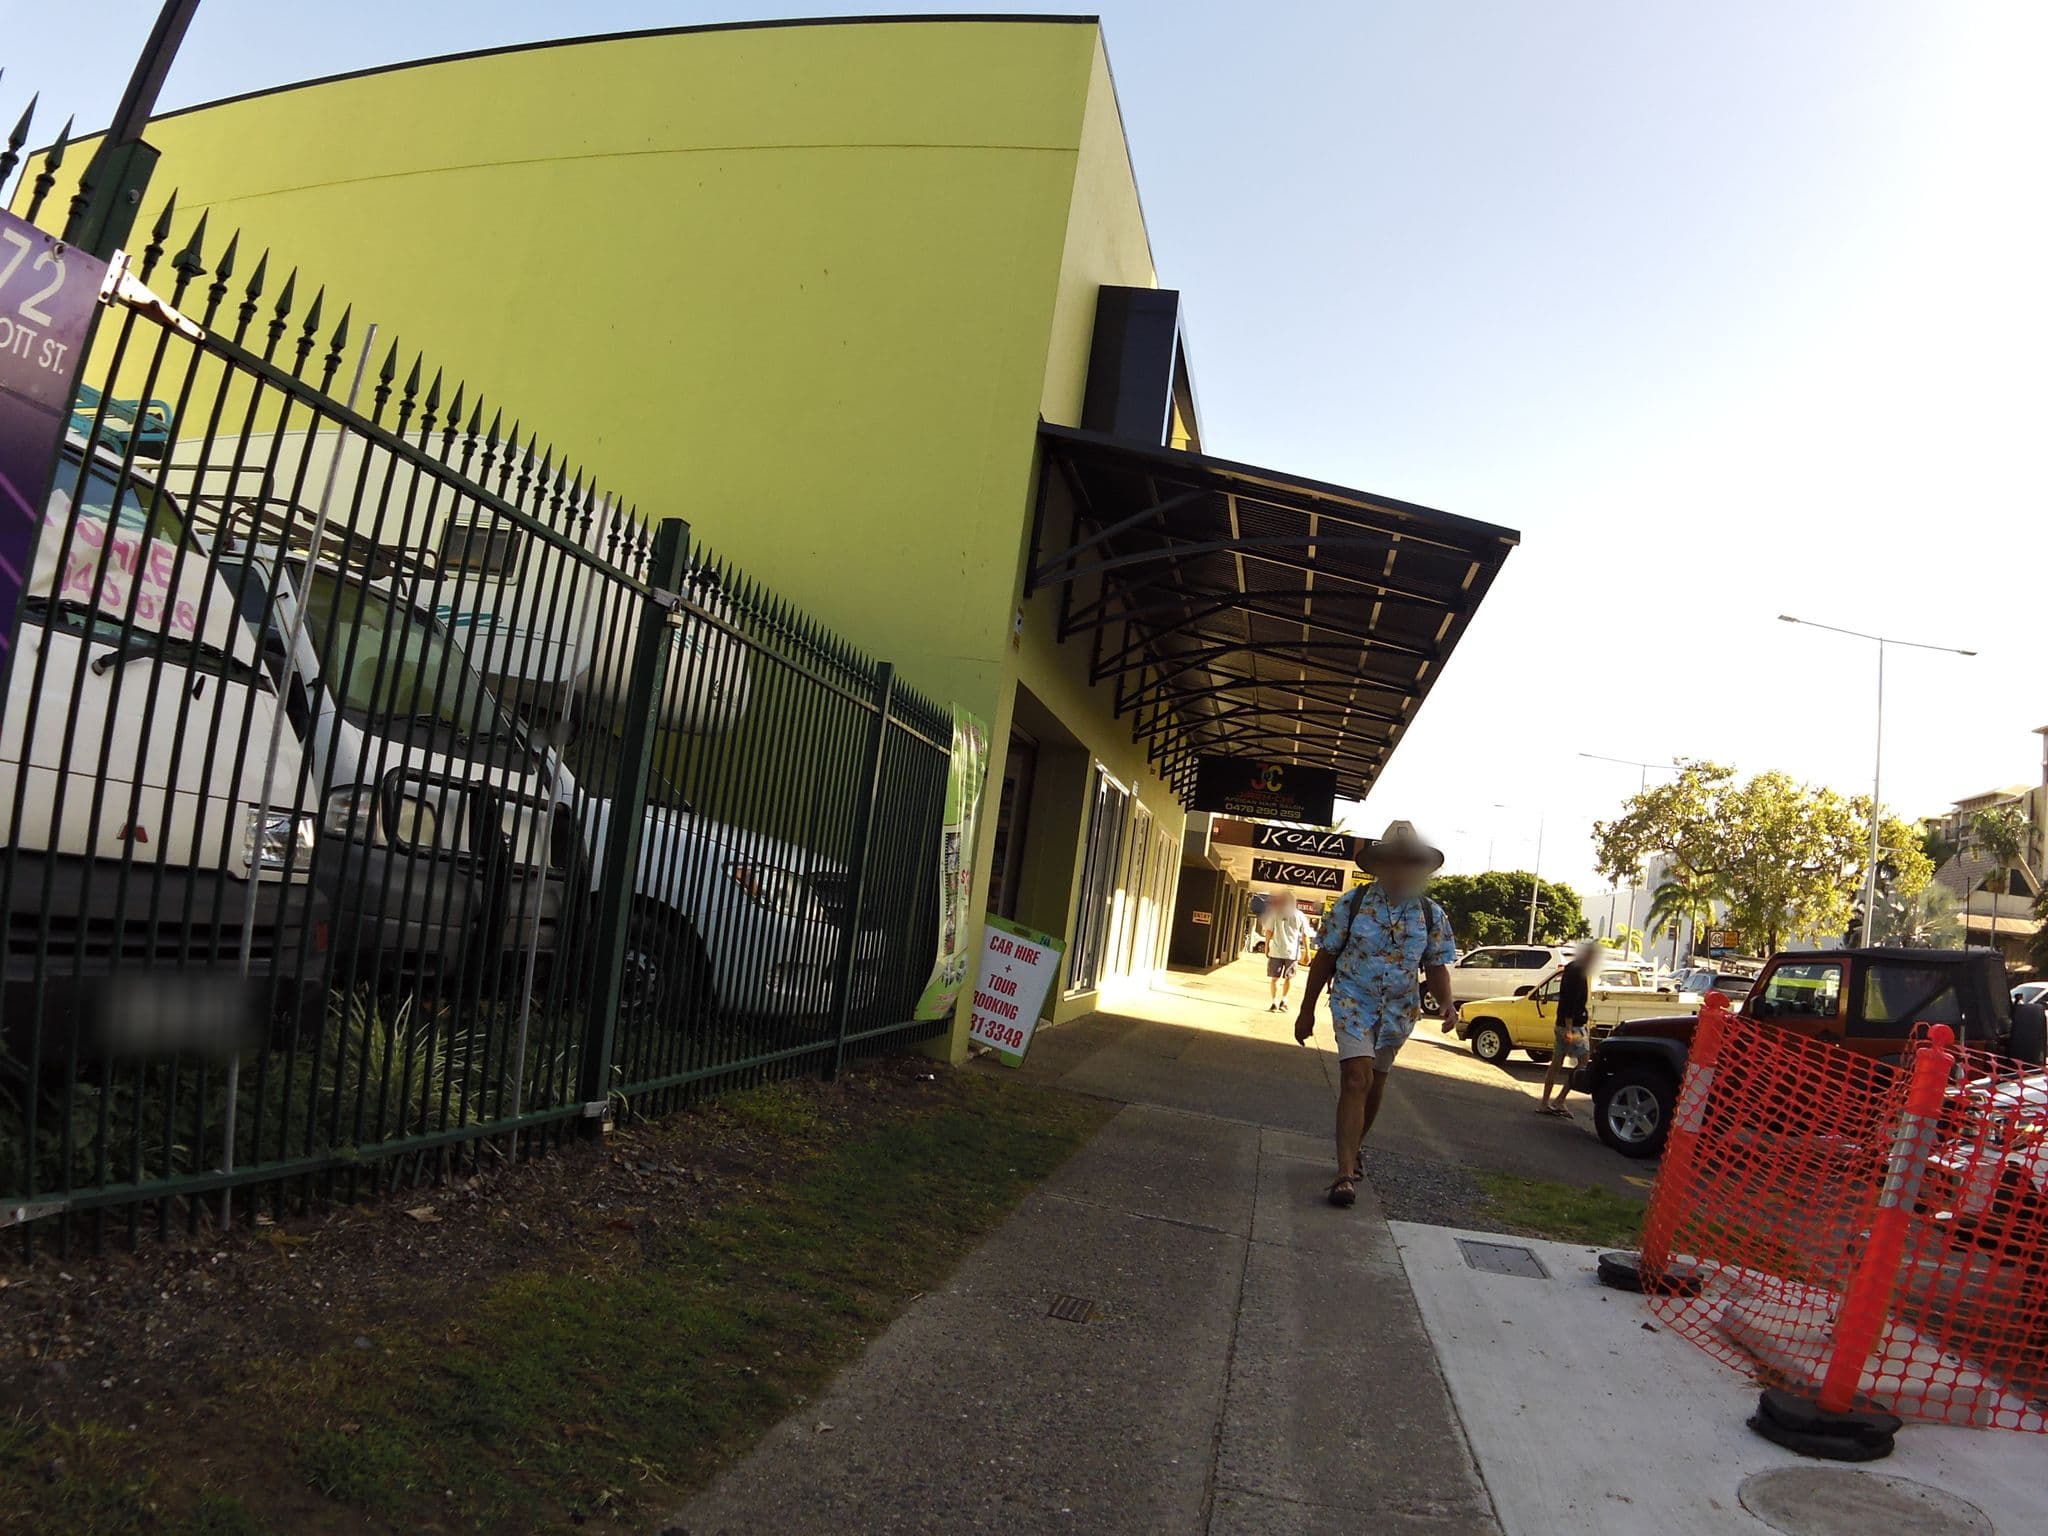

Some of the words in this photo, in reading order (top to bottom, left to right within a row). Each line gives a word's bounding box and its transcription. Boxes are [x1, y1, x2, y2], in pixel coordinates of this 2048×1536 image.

[38, 338, 68, 375] ST.
[1260, 828, 1345, 853] KOALA
[1274, 864, 1338, 885] KOALA
[989, 935, 1014, 956] CAR
[1014, 944, 1041, 966] HIRE
[987, 973, 1018, 997] TOUR
